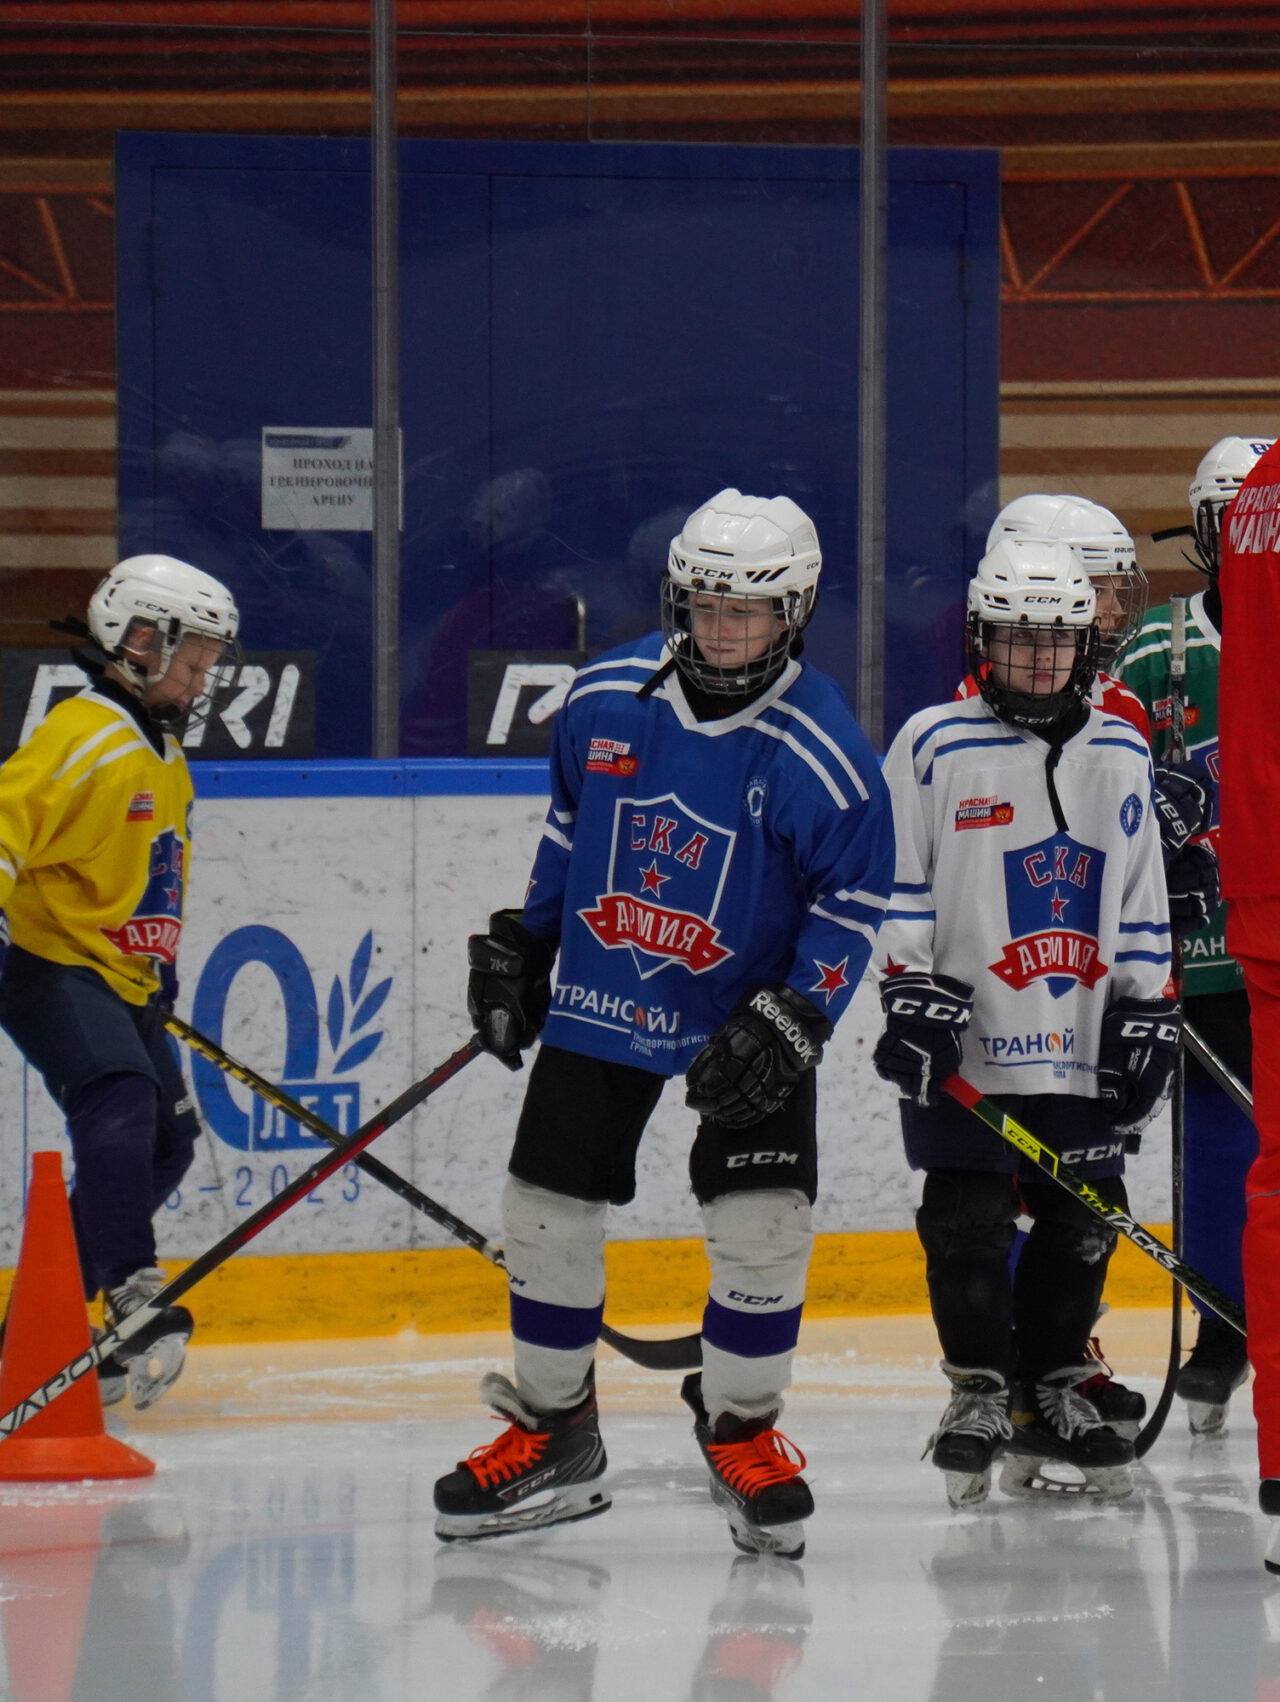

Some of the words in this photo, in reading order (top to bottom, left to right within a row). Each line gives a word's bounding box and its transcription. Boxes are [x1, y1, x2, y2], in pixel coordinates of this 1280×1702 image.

[690, 566, 735, 580] CCM
[134, 600, 170, 615] CCM
[1024, 596, 1062, 604] CCM
[631, 814, 709, 870] СКА
[1023, 846, 1091, 888] СКА
[616, 902, 702, 953] АРМИЯ
[1017, 936, 1096, 976] АРМИЯ
[749, 990, 818, 1065] Reebok
[1120, 1021, 1181, 1044] CC
[1007, 1128, 1038, 1155] CCM
[1060, 1142, 1123, 1165] CCM
[726, 1150, 799, 1169] CCM
[1106, 1213, 1180, 1270] TACKS
[727, 1290, 785, 1307] CCM
[518, 1467, 556, 1496] CCM
